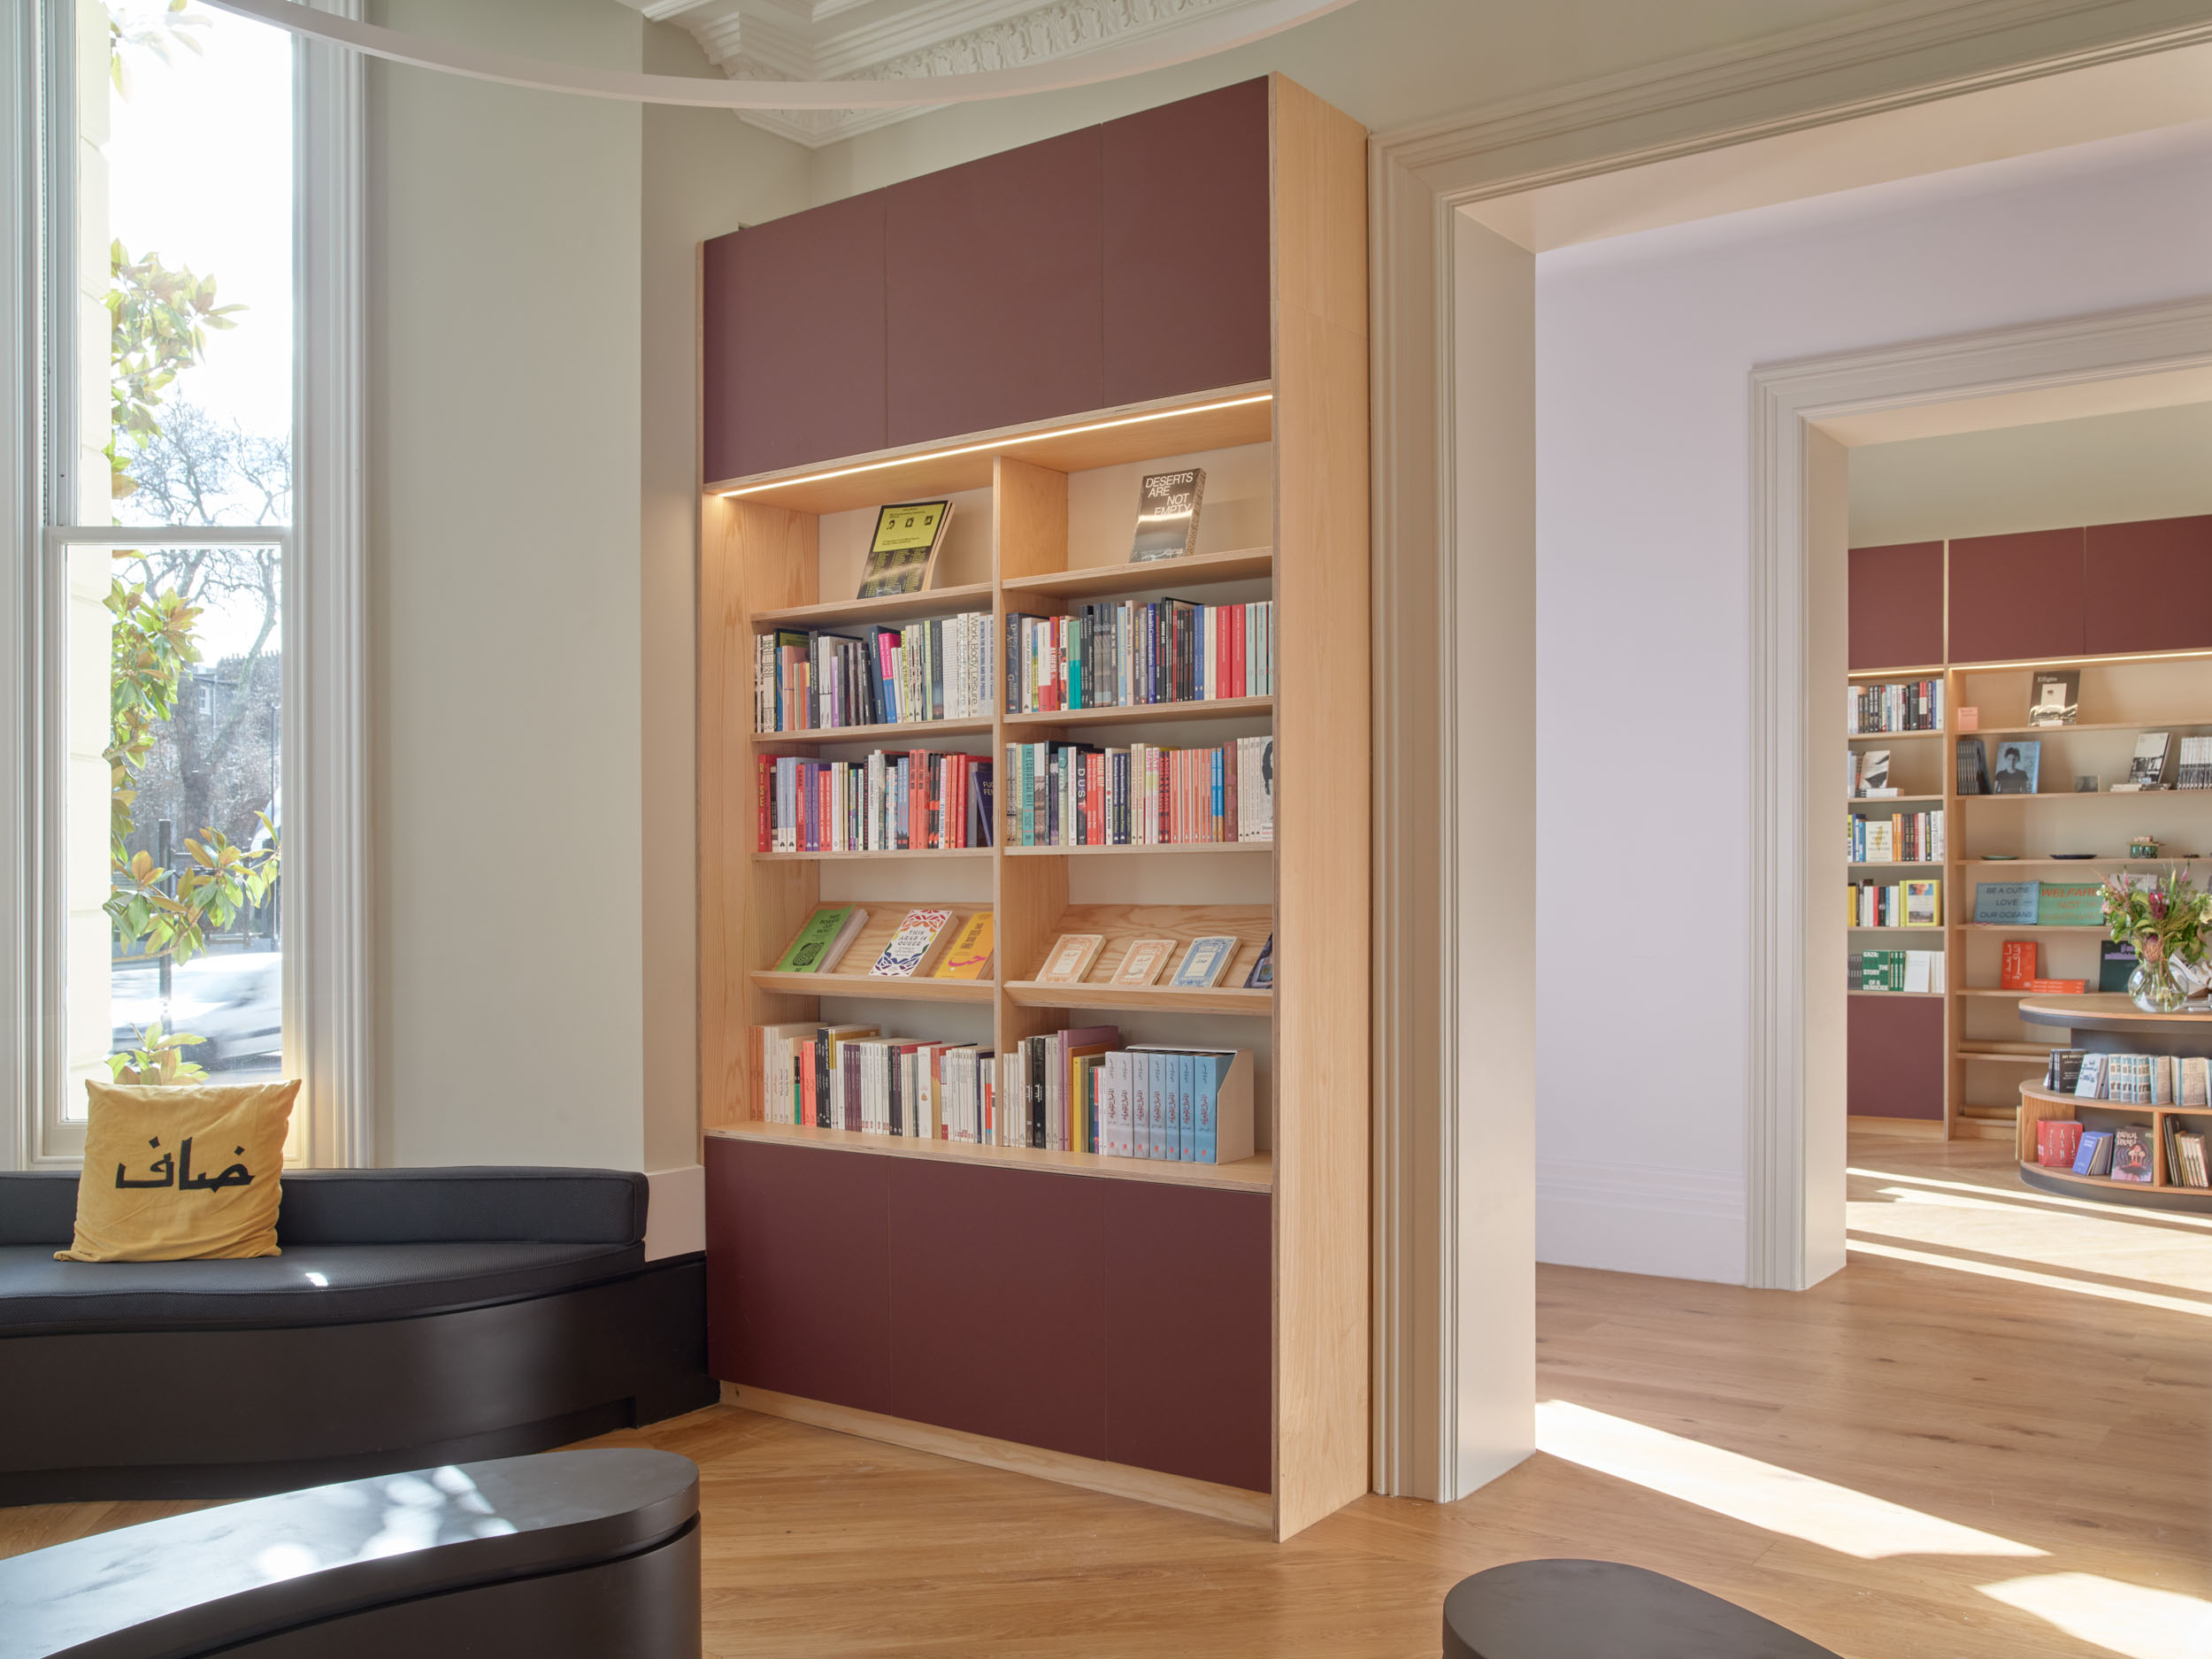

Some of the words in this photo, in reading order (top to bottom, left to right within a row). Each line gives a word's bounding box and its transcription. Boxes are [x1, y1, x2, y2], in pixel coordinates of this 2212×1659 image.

[1146, 472, 1194, 488] DESERTS
[1148, 486, 1171, 498] ARE
[1167, 493, 1190, 506] NOT
[1154, 503, 1191, 517] EMPTY
[970, 615, 978, 643] Work,
[970, 644, 978, 669] Body,
[2041, 887, 2101, 898] WELFARE
[2058, 901, 2081, 909] NOT
